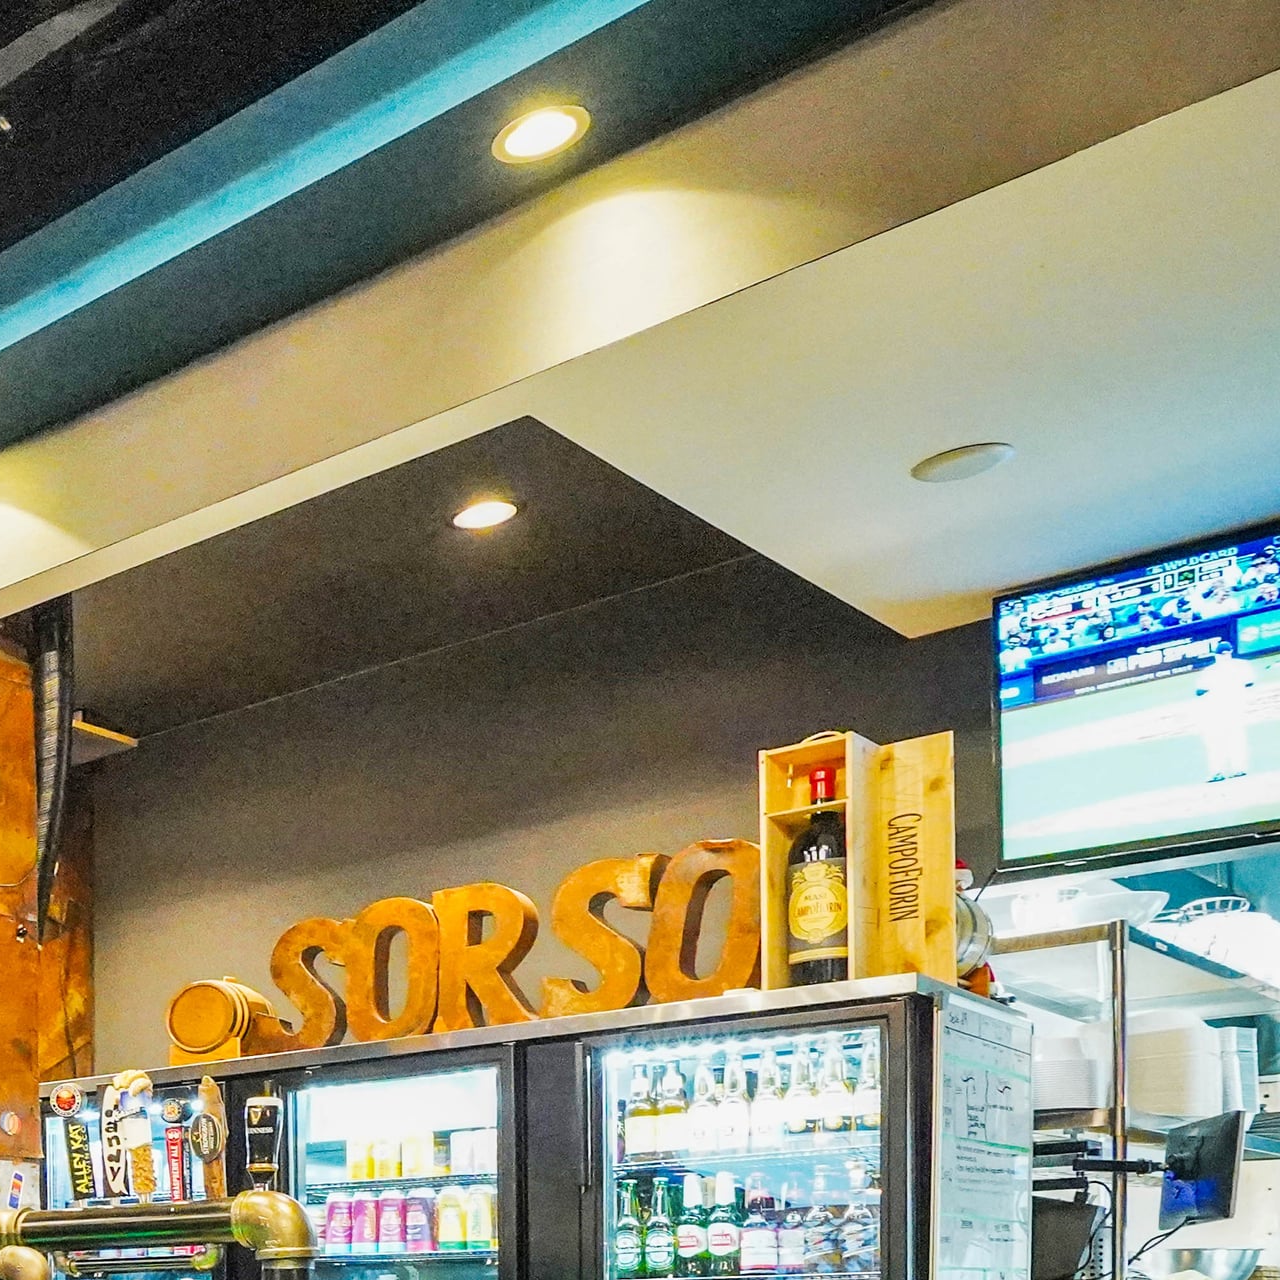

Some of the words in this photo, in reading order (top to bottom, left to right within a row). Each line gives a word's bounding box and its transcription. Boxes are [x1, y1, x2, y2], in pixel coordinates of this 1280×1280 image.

[241, 839, 761, 1055] SORSO
[68, 1123, 84, 1150] KAT
[72, 1152, 89, 1193] ALLEY
